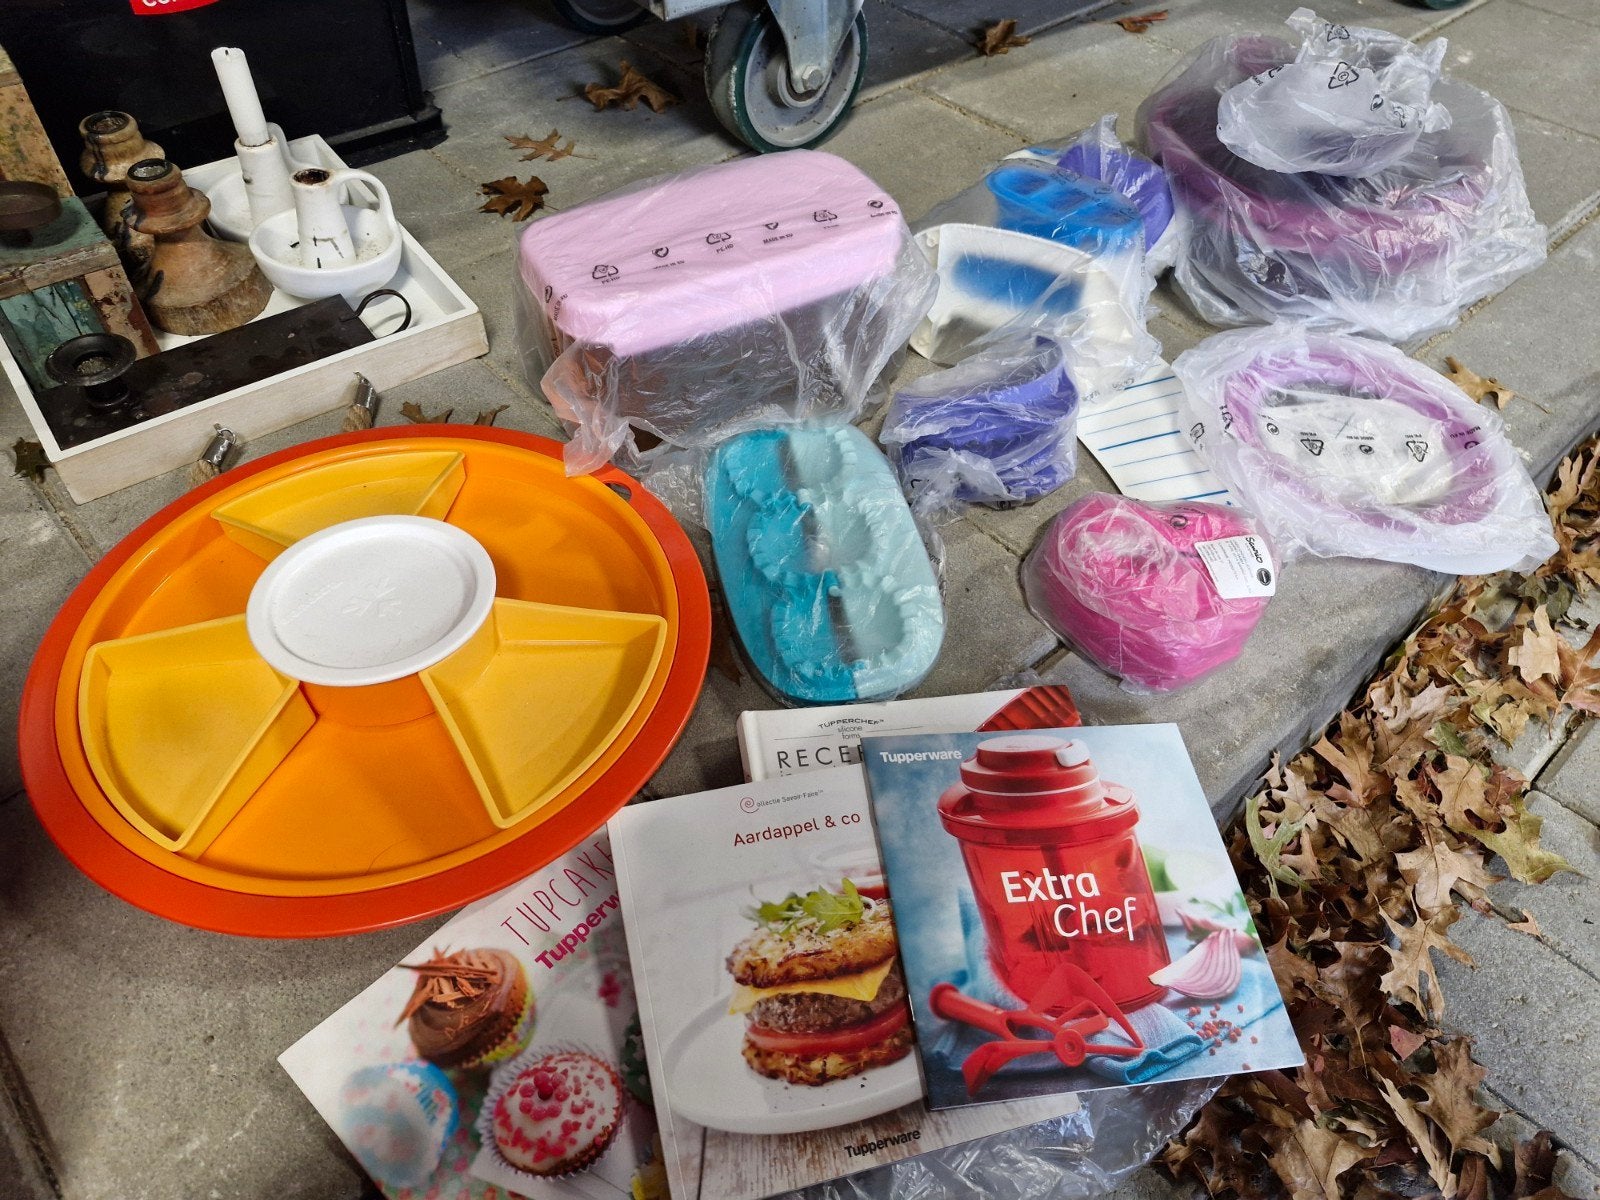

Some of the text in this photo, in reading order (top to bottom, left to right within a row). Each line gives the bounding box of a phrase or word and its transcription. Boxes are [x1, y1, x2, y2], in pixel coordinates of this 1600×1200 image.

[837, 725, 863, 733] silicone
[880, 750, 962, 764] Tupperware
[734, 813, 860, 847] Aardappel & co
[501, 837, 614, 946] TUPCAKE
[1000, 868, 1100, 903] Extra
[1054, 897, 1137, 941] Chef
[844, 1130, 921, 1158] Tupperware
